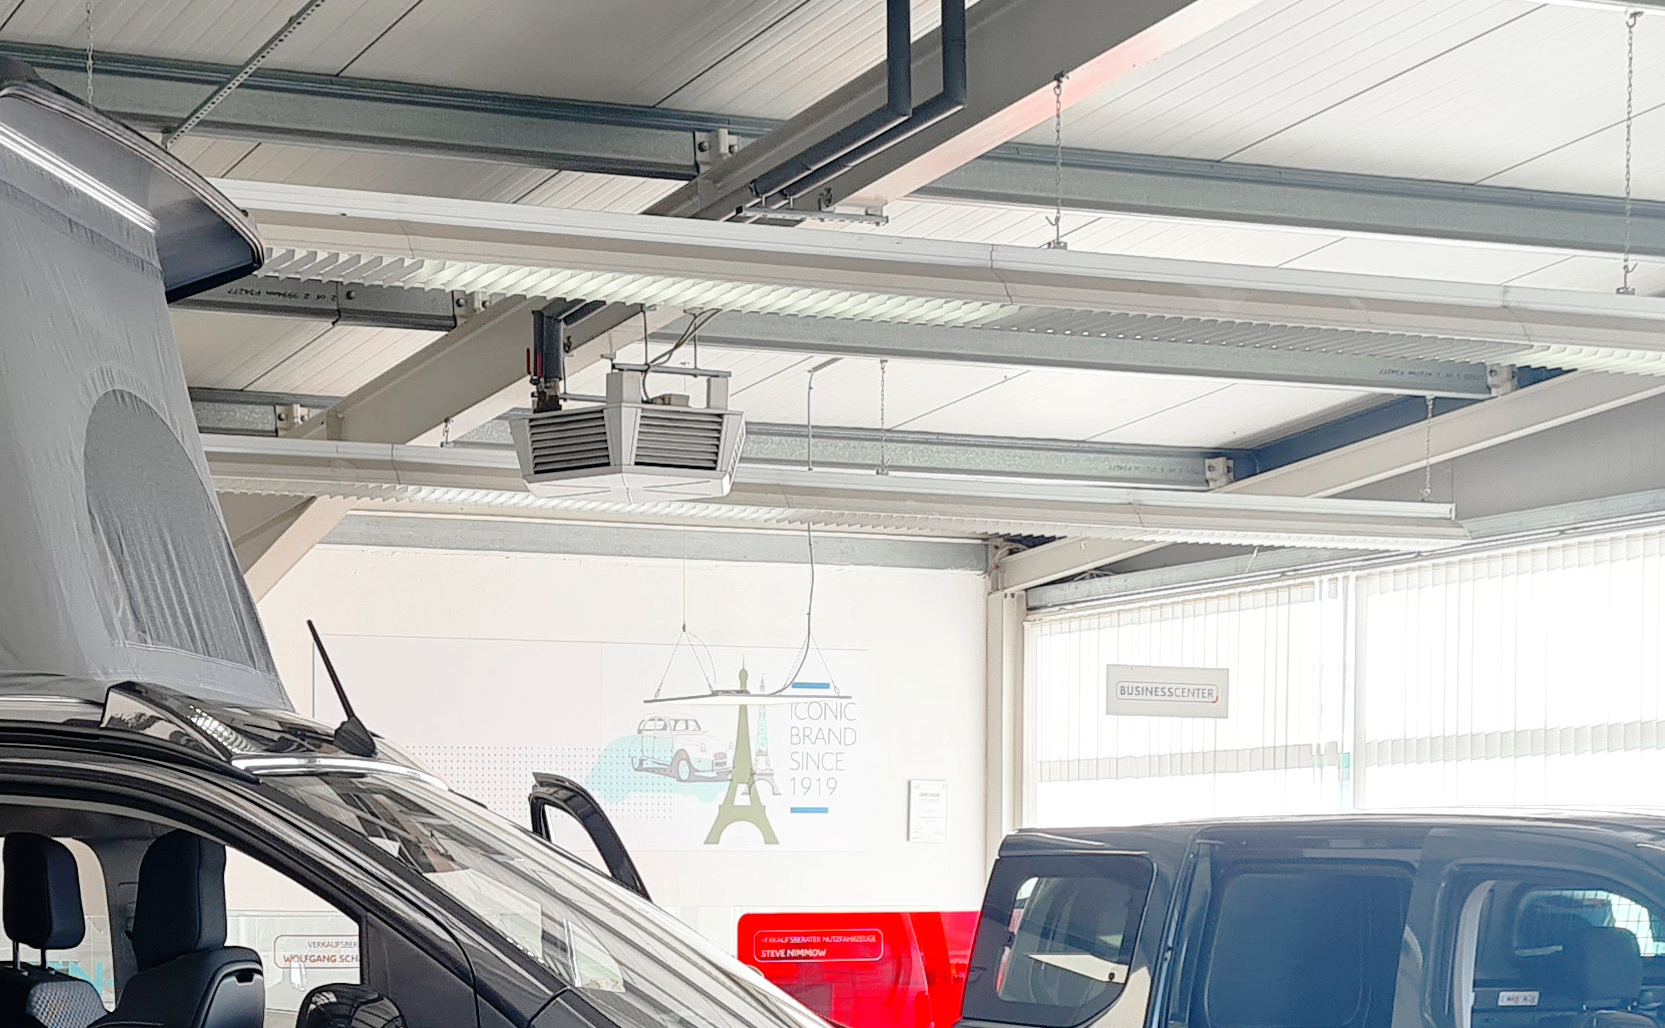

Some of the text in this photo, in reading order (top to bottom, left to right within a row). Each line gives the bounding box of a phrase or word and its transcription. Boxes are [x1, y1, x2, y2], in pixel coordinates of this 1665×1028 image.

[1120, 685, 1214, 698] BUSINESSCENTER
[790, 701, 857, 721] ICONIC
[790, 726, 857, 746] BRAND
[790, 751, 846, 771] SINCE
[790, 776, 838, 796] 1919
[283, 954, 337, 963] WOLFGANG
[761, 948, 827, 958] STEVE NIMMOW
